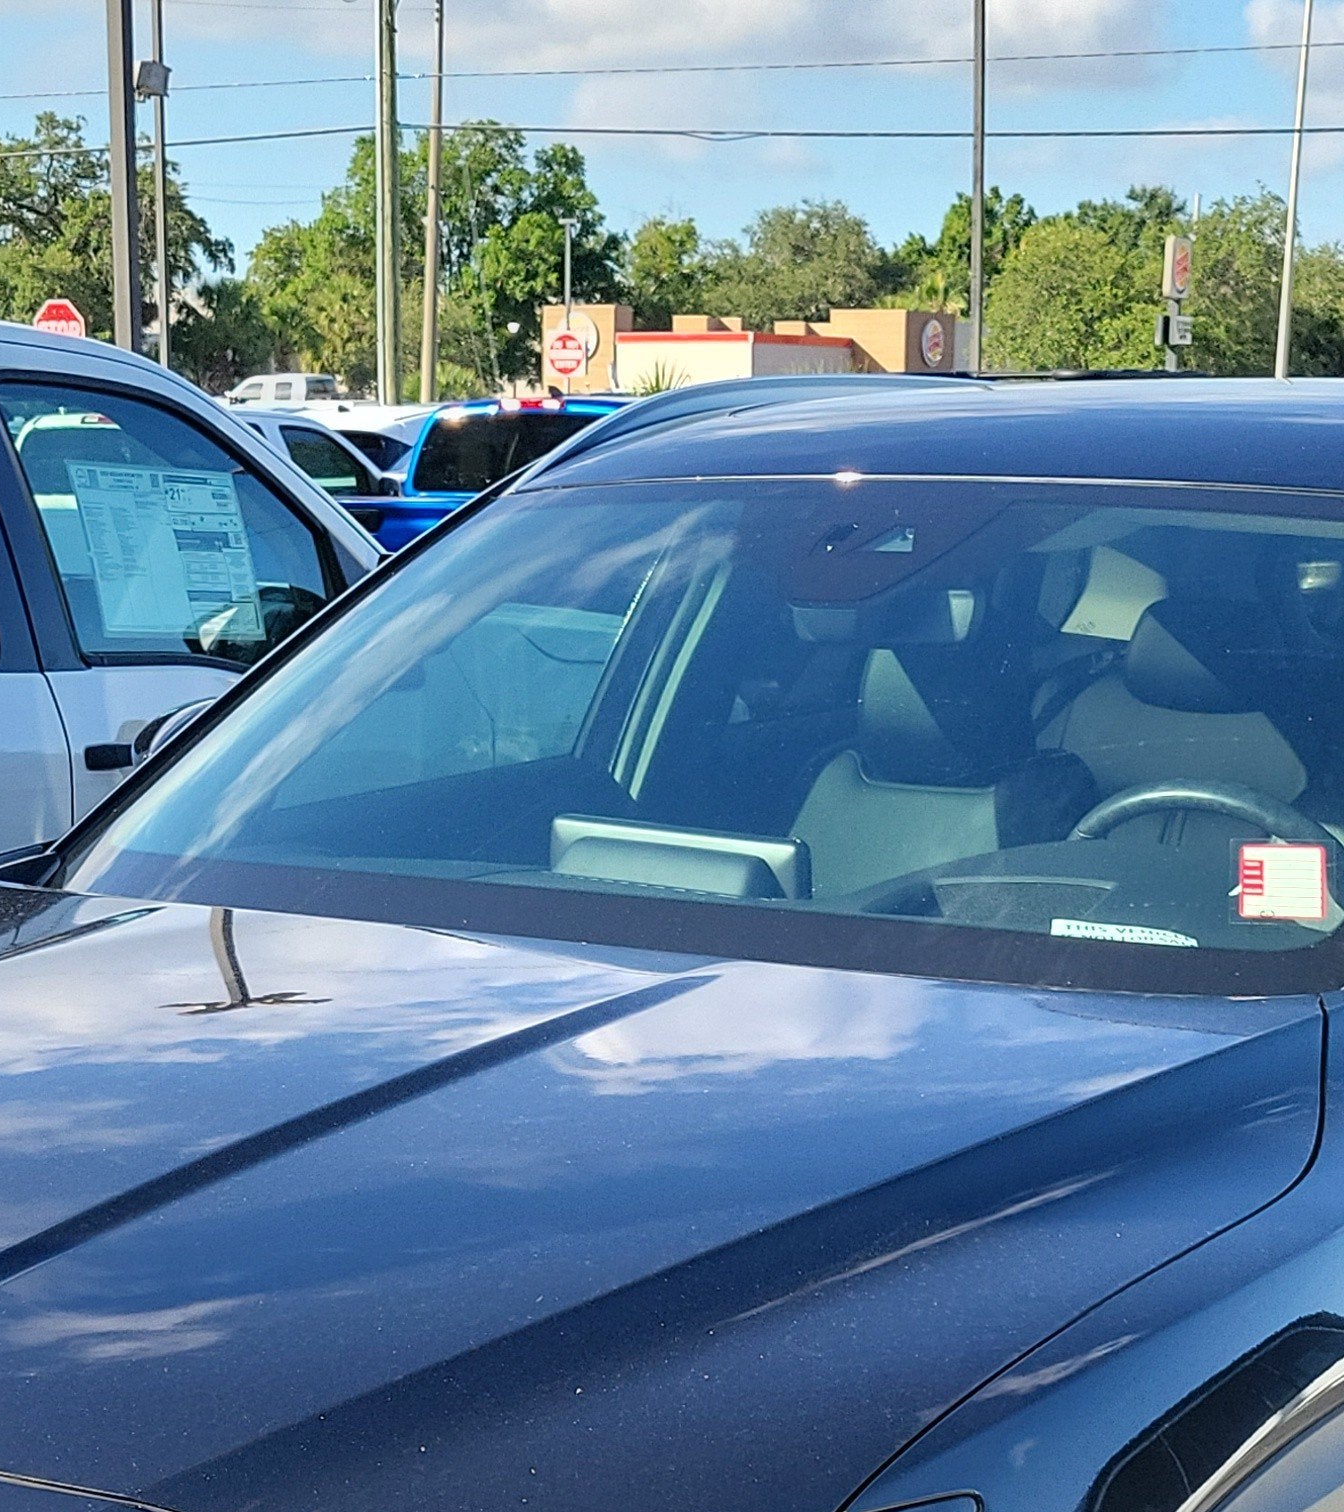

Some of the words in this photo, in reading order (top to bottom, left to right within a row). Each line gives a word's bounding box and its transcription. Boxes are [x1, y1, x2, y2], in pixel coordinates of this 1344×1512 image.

[37, 319, 81, 338] STOP
[1066, 924, 1108, 934] THIS
[1115, 927, 1189, 942] VEHICLE
